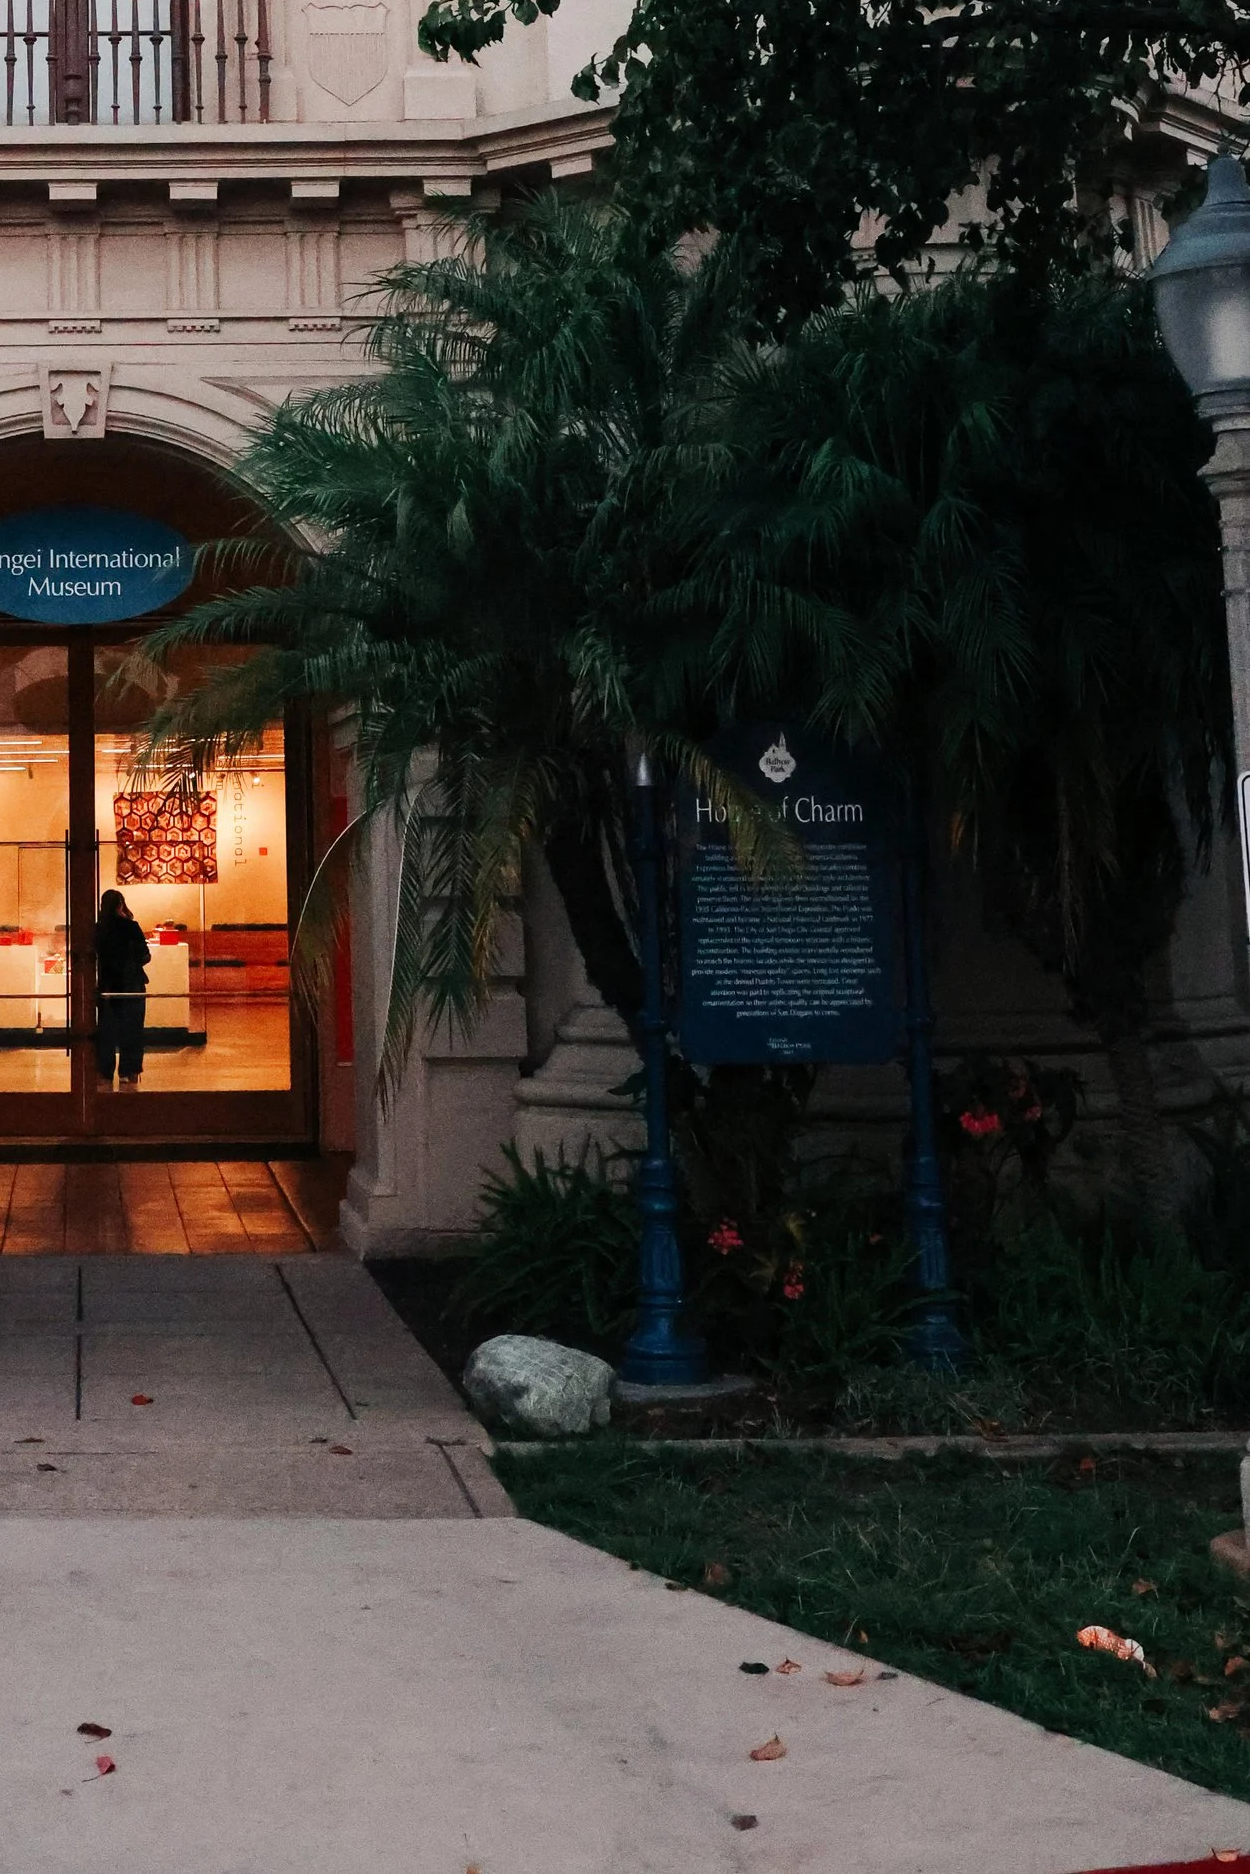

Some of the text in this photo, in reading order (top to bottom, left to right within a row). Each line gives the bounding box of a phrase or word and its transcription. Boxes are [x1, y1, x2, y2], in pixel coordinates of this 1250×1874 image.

[49, 546, 180, 569] International
[28, 577, 122, 596] Museum
[795, 795, 863, 823] Charm
